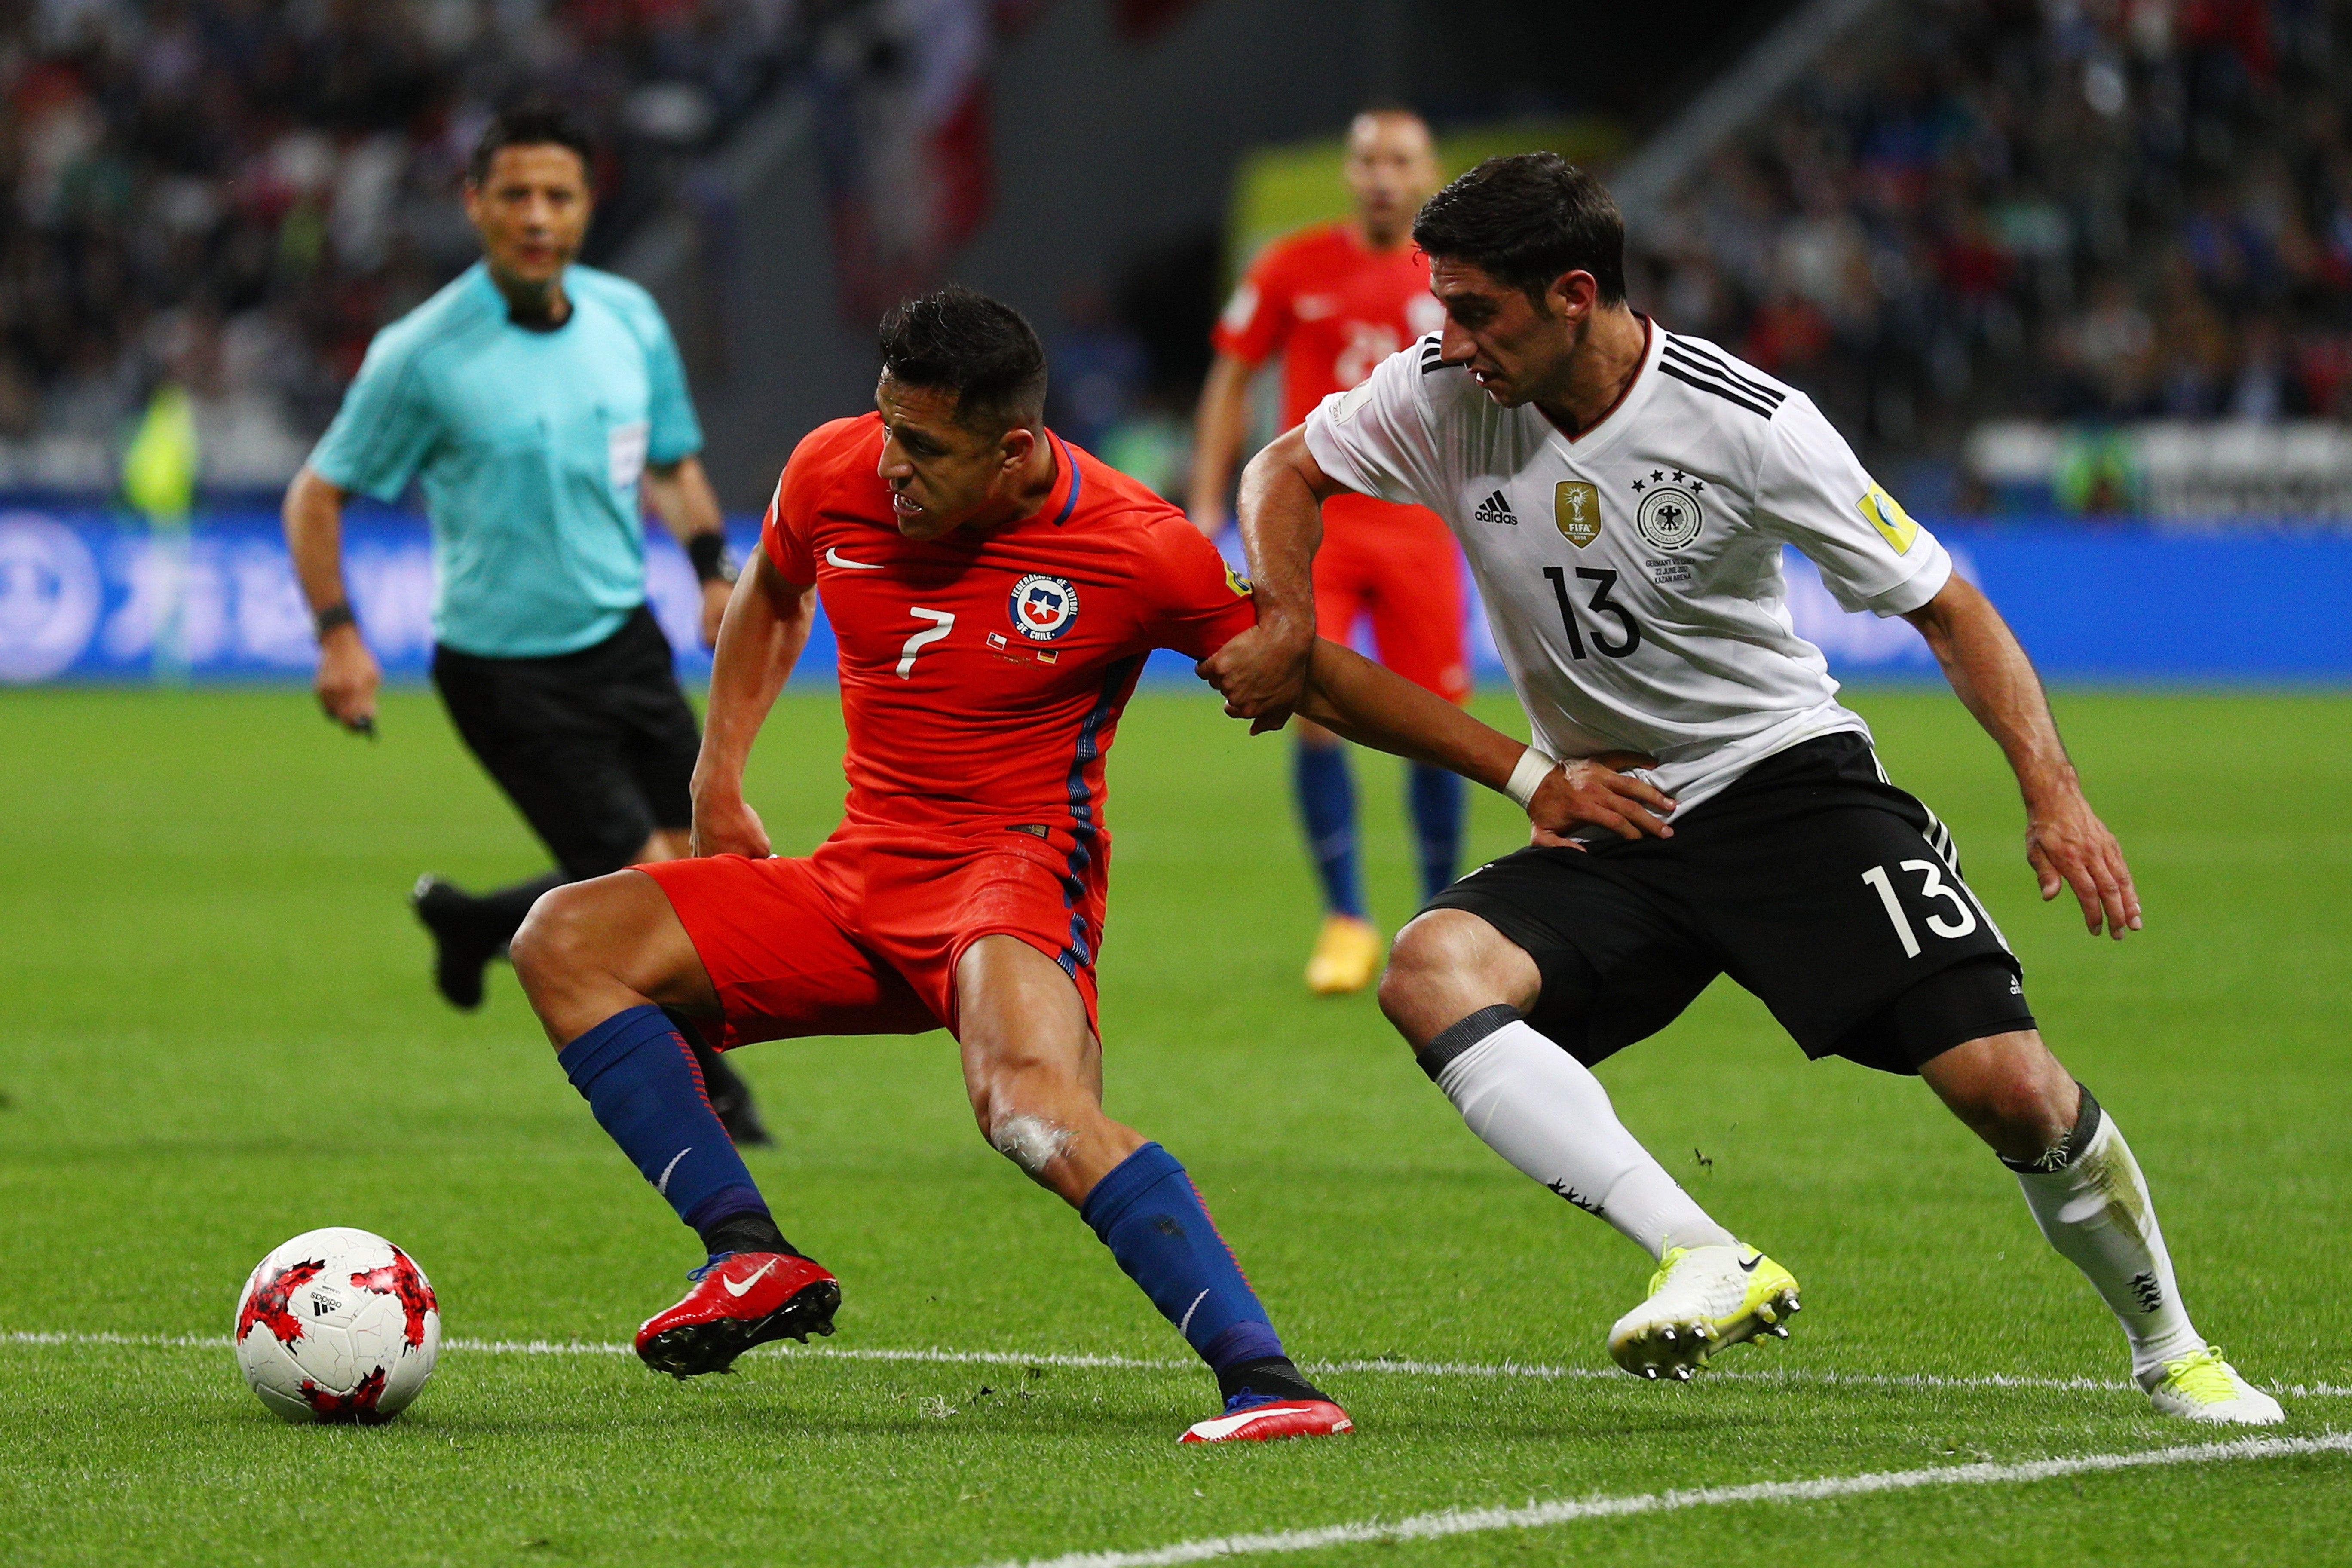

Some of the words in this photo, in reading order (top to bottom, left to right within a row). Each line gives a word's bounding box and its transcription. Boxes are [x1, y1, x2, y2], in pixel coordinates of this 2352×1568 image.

[1475, 511, 1518, 525] adidas
[1569, 524, 1591, 532] FIFA
[1065, 587, 1078, 616] FUTBOL
[1543, 567, 1641, 660] 13
[1016, 622, 1028, 634] DE
[1029, 632, 1052, 640] CHILE
[896, 606, 955, 680] 7
[1861, 859, 1977, 959] 13
[310, 1292, 342, 1308] adidas
